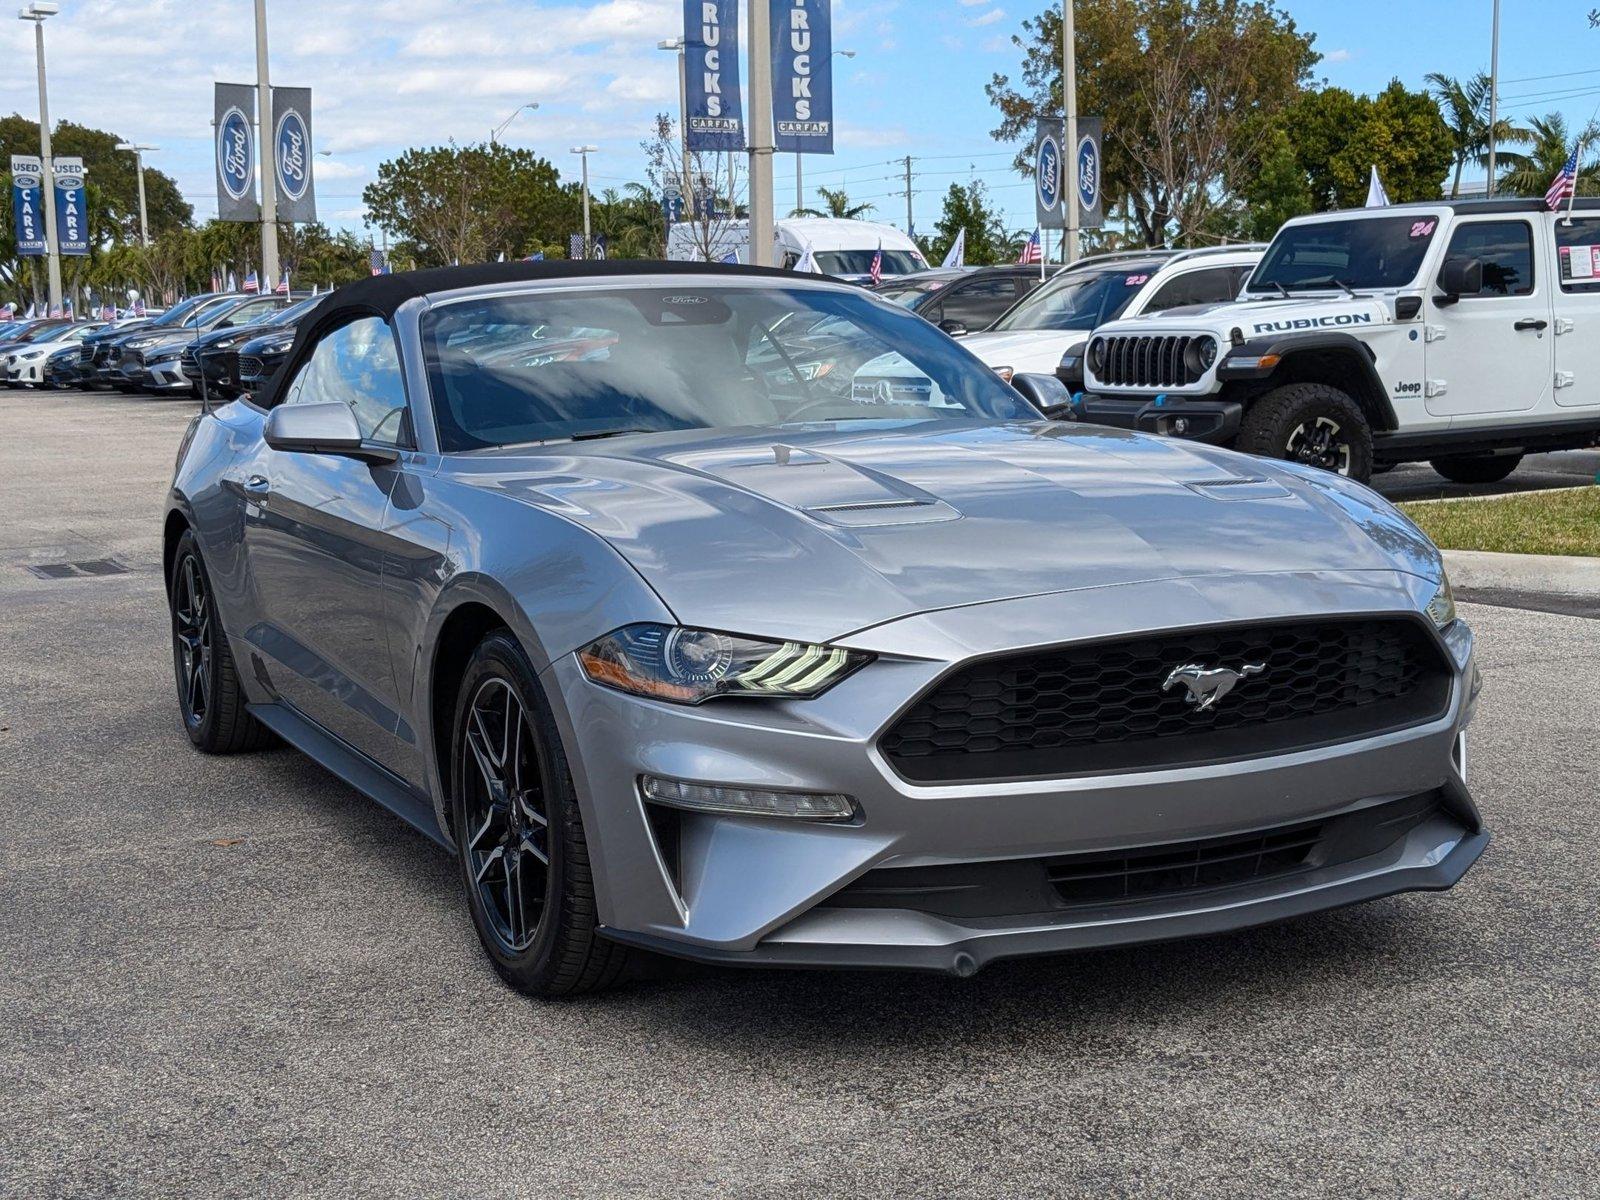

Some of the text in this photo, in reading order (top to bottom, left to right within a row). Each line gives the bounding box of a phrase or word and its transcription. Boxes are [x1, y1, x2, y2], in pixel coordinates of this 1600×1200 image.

[691, 119, 737, 130] CARFAX
[778, 122, 828, 133] CARFAX
[225, 127, 246, 179] Ford
[282, 129, 304, 180] Ford
[13, 163, 39, 172] USED
[55, 165, 82, 173] USED
[1041, 153, 1055, 194] Ford
[1080, 153, 1094, 194] Ford
[21, 189, 35, 240] CARS
[65, 190, 78, 240] CARS
[1410, 221, 1435, 237] 24
[1253, 313, 1371, 333] RUBICON
[1394, 381, 1421, 393] Jeep
